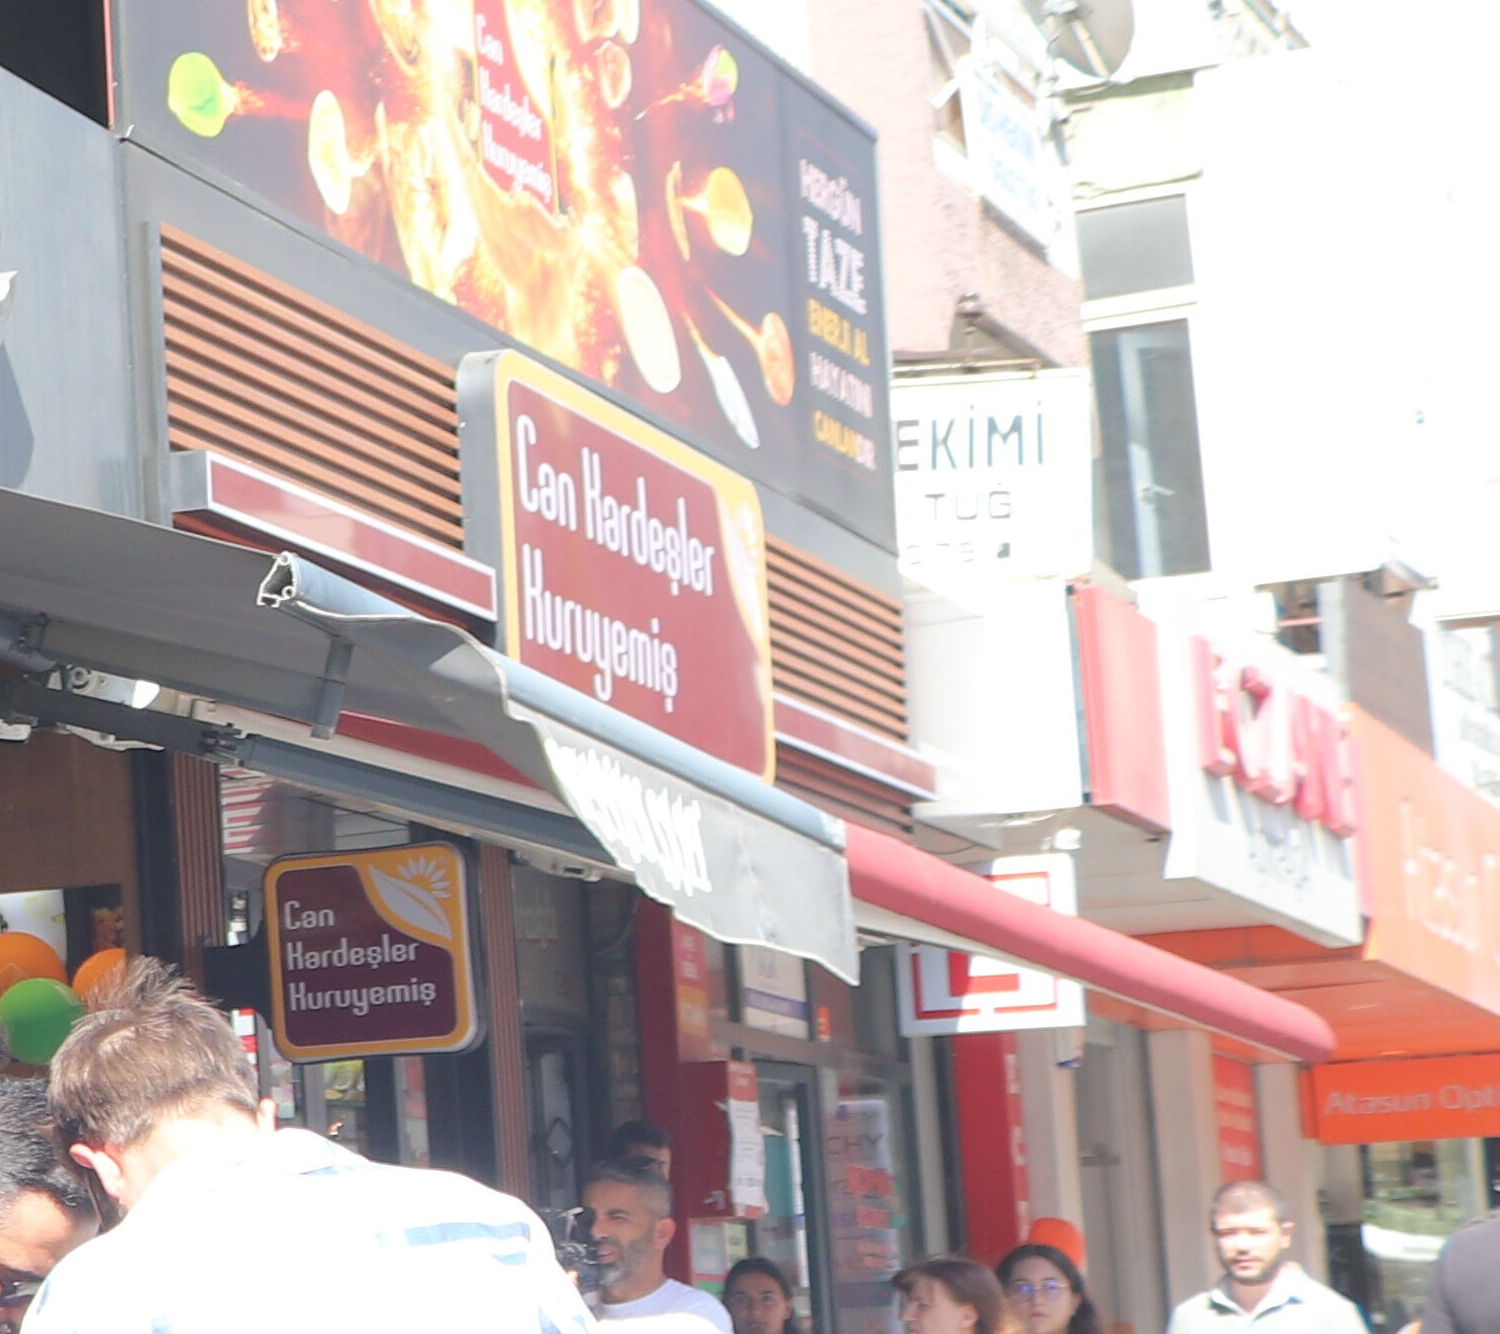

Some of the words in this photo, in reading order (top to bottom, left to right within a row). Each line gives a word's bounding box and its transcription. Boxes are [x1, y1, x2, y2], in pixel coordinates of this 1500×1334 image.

[516, 413, 577, 531] Can
[583, 452, 715, 596] Kardeşler
[522, 544, 678, 712] Kuruyemiş
[284, 900, 335, 932] Can
[287, 940, 420, 972] Kardeşler
[289, 978, 436, 1016] Kuruyemiş
